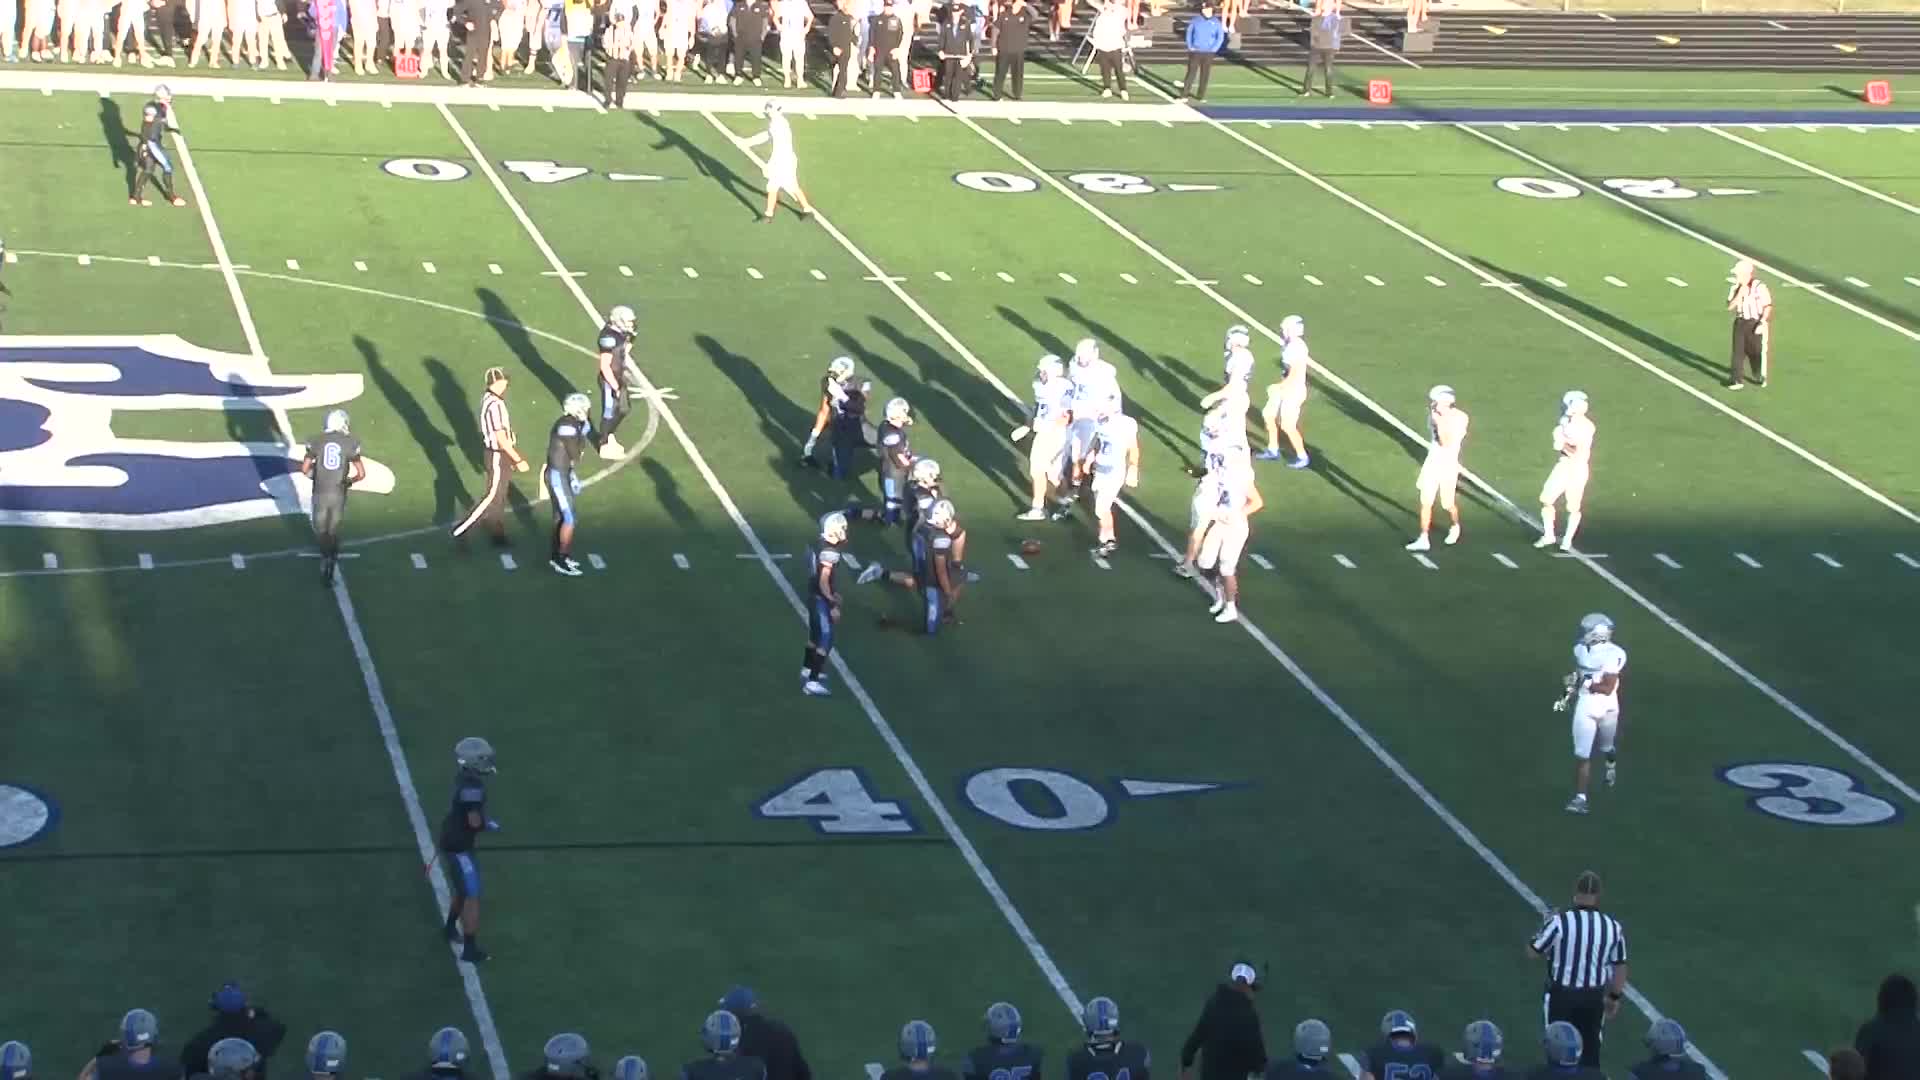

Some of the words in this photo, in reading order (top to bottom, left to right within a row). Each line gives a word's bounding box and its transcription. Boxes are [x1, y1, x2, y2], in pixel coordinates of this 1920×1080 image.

[397, 57, 417, 74] 40
[1371, 83, 1389, 100] 20
[323, 441, 342, 471] 6
[756, 765, 1112, 833] 40
[1720, 760, 1902, 828] 3
